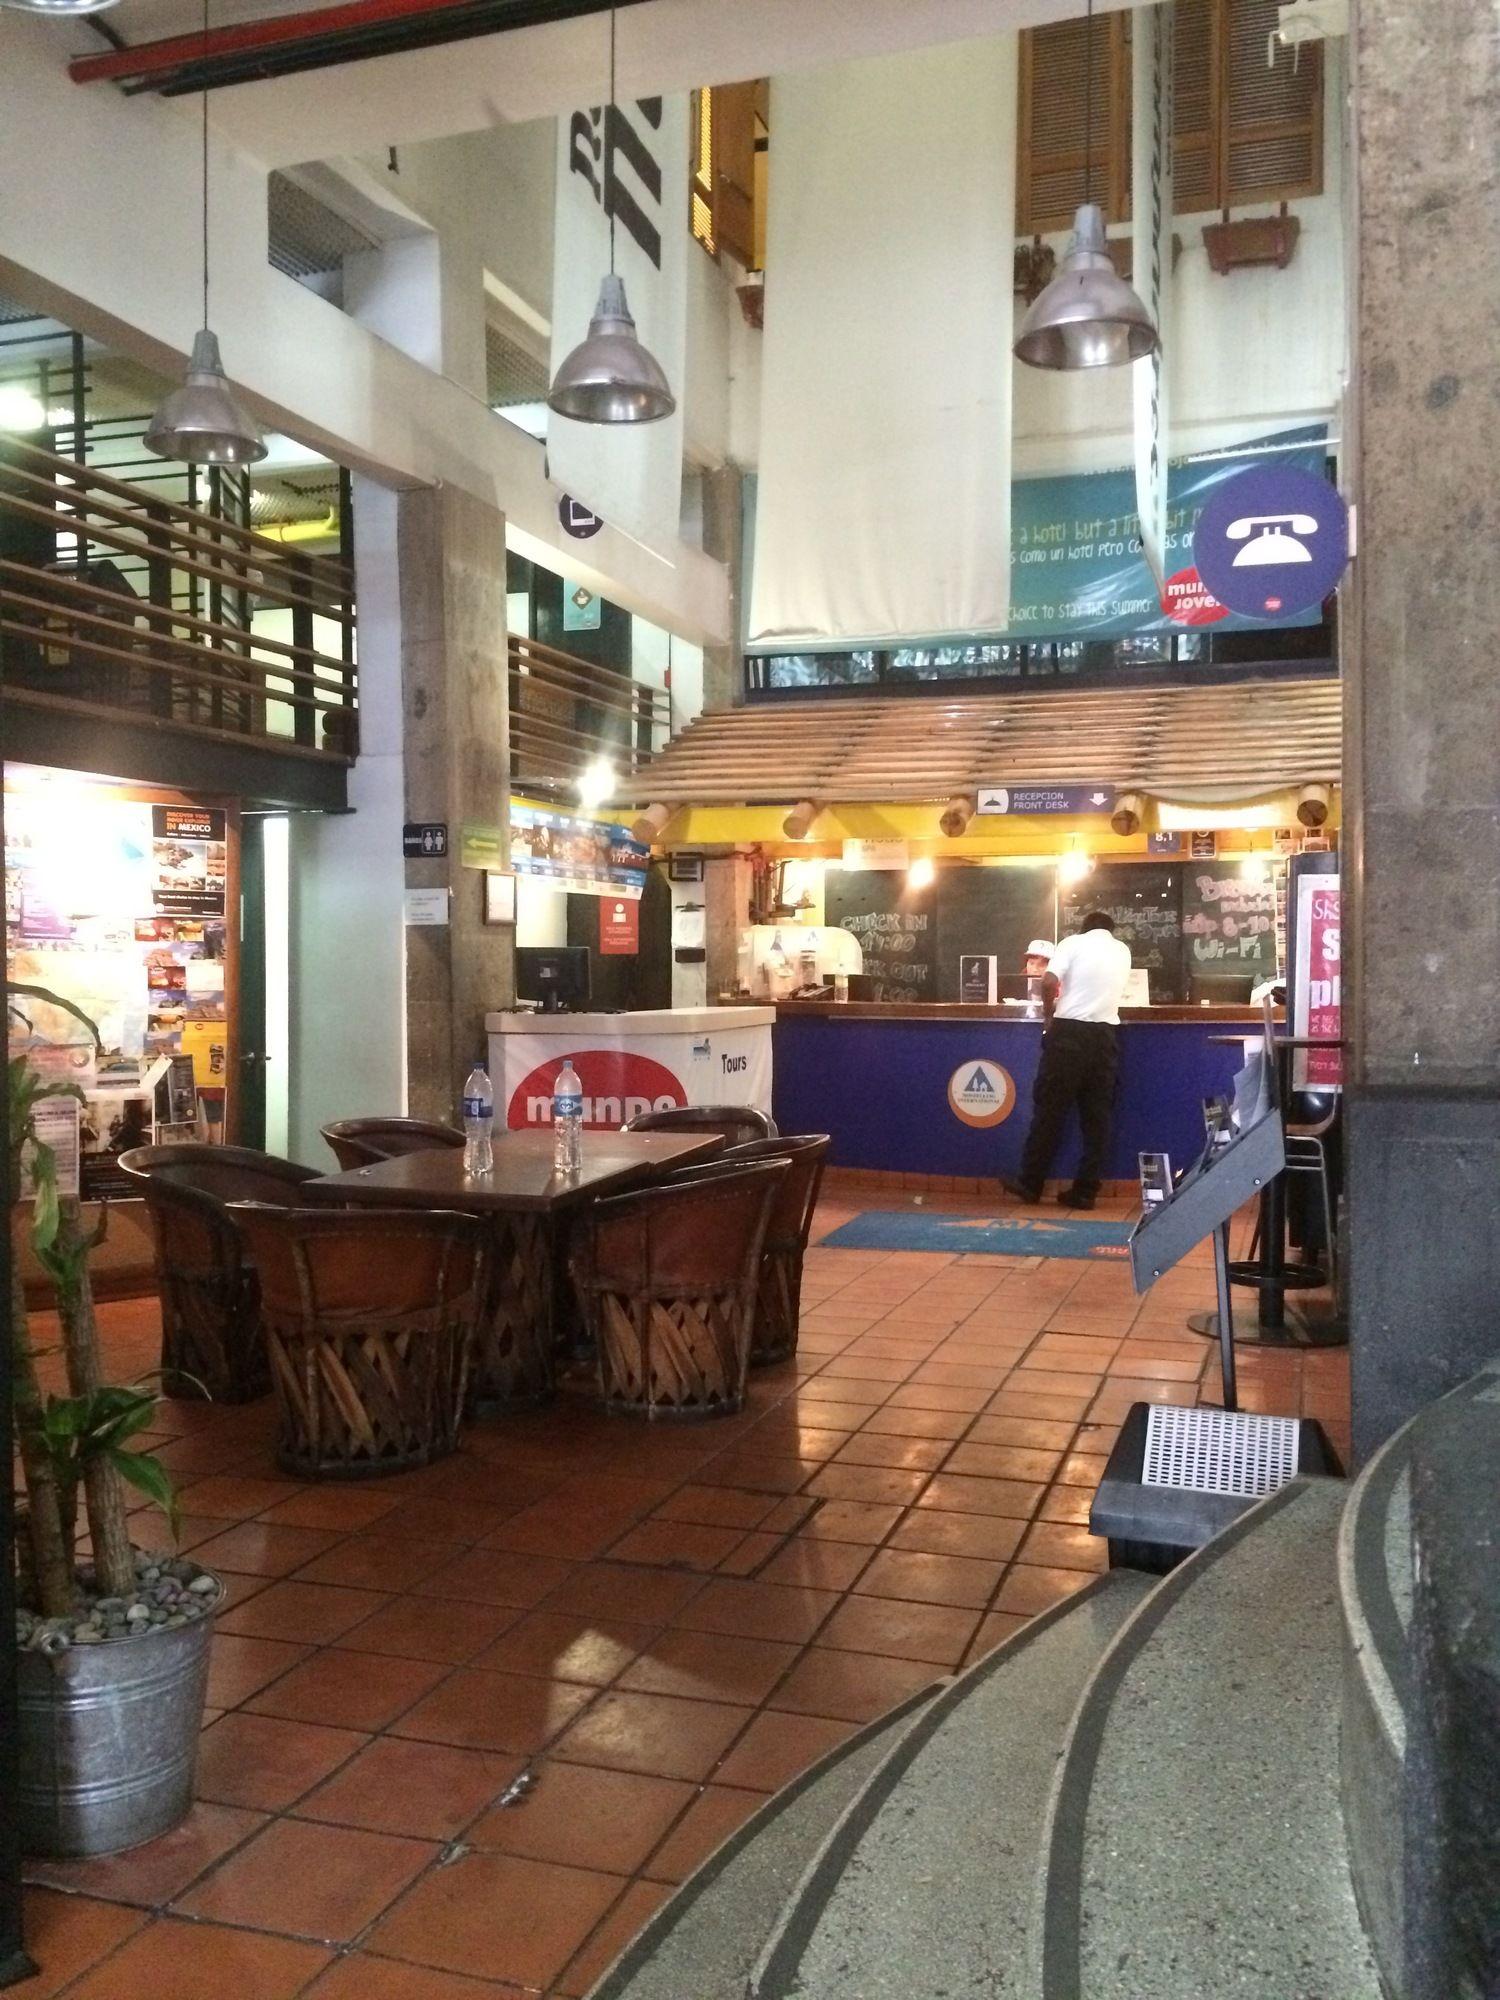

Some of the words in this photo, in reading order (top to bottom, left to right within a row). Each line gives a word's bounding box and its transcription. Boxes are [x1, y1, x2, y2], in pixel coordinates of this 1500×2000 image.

[1033, 522, 1066, 544] hotel
[1075, 518, 1102, 541] but
[1020, 550, 1047, 564] como
[1050, 547, 1065, 561] un
[1068, 543, 1094, 560] hotel
[1041, 604, 1055, 619] to
[1013, 791, 1064, 801] RECEPCION
[1013, 801, 1043, 810] FRONT
[1045, 800, 1070, 810] DESK
[166, 822, 176, 830] IN
[178, 823, 211, 832] MEXICO
[840, 912, 901, 932] CHECK
[905, 914, 928, 931] IN
[721, 1053, 747, 1074] Tours
